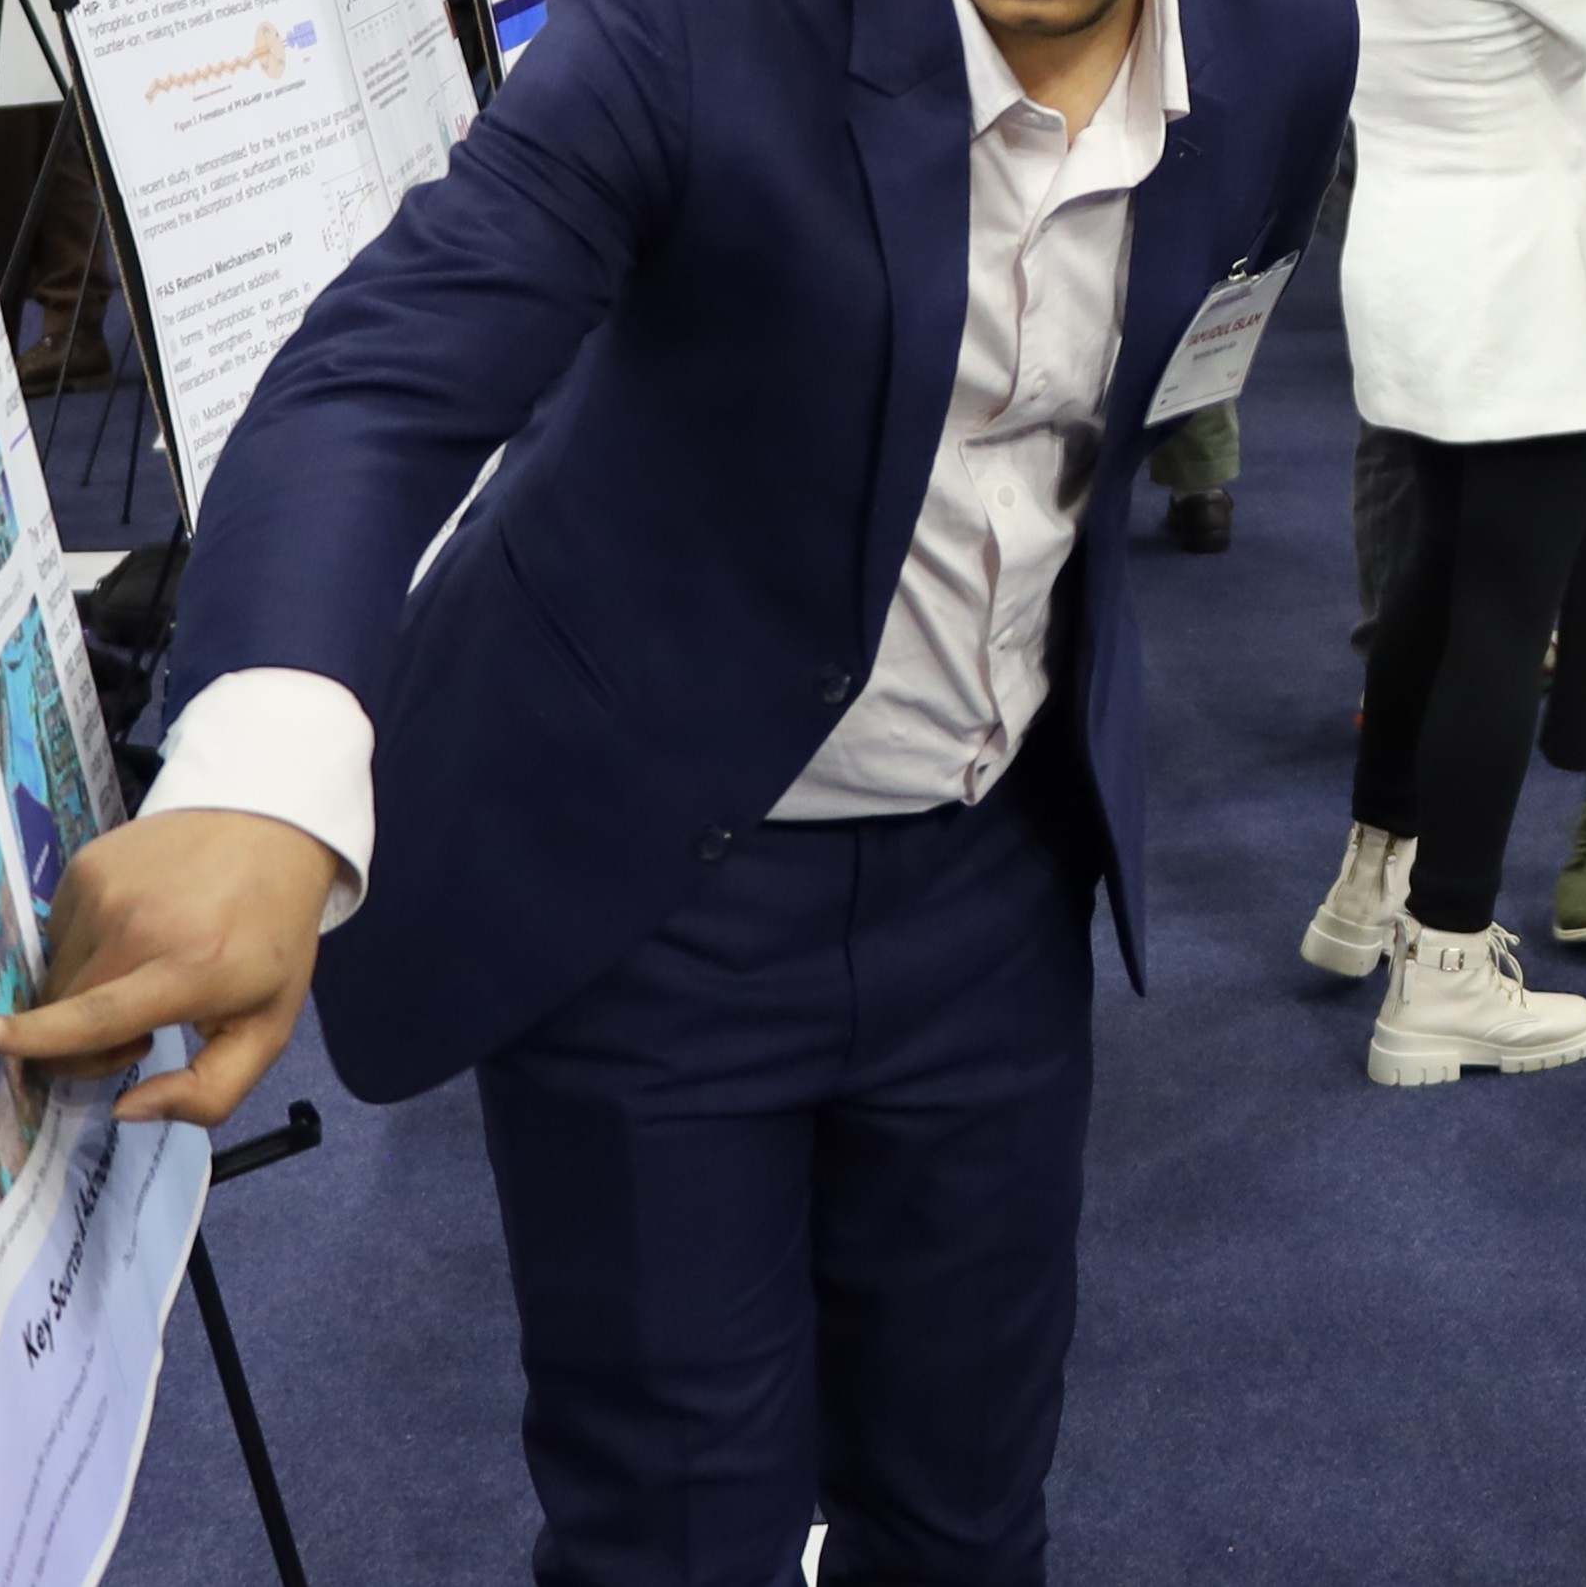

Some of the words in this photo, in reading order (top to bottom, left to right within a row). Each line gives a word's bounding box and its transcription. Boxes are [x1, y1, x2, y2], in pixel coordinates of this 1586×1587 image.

[176, 270, 215, 292] Removal
[214, 244, 265, 276] Mechanism
[265, 239, 279, 257] by
[279, 230, 294, 249] HIP
[21, 1309, 55, 1370] Key
